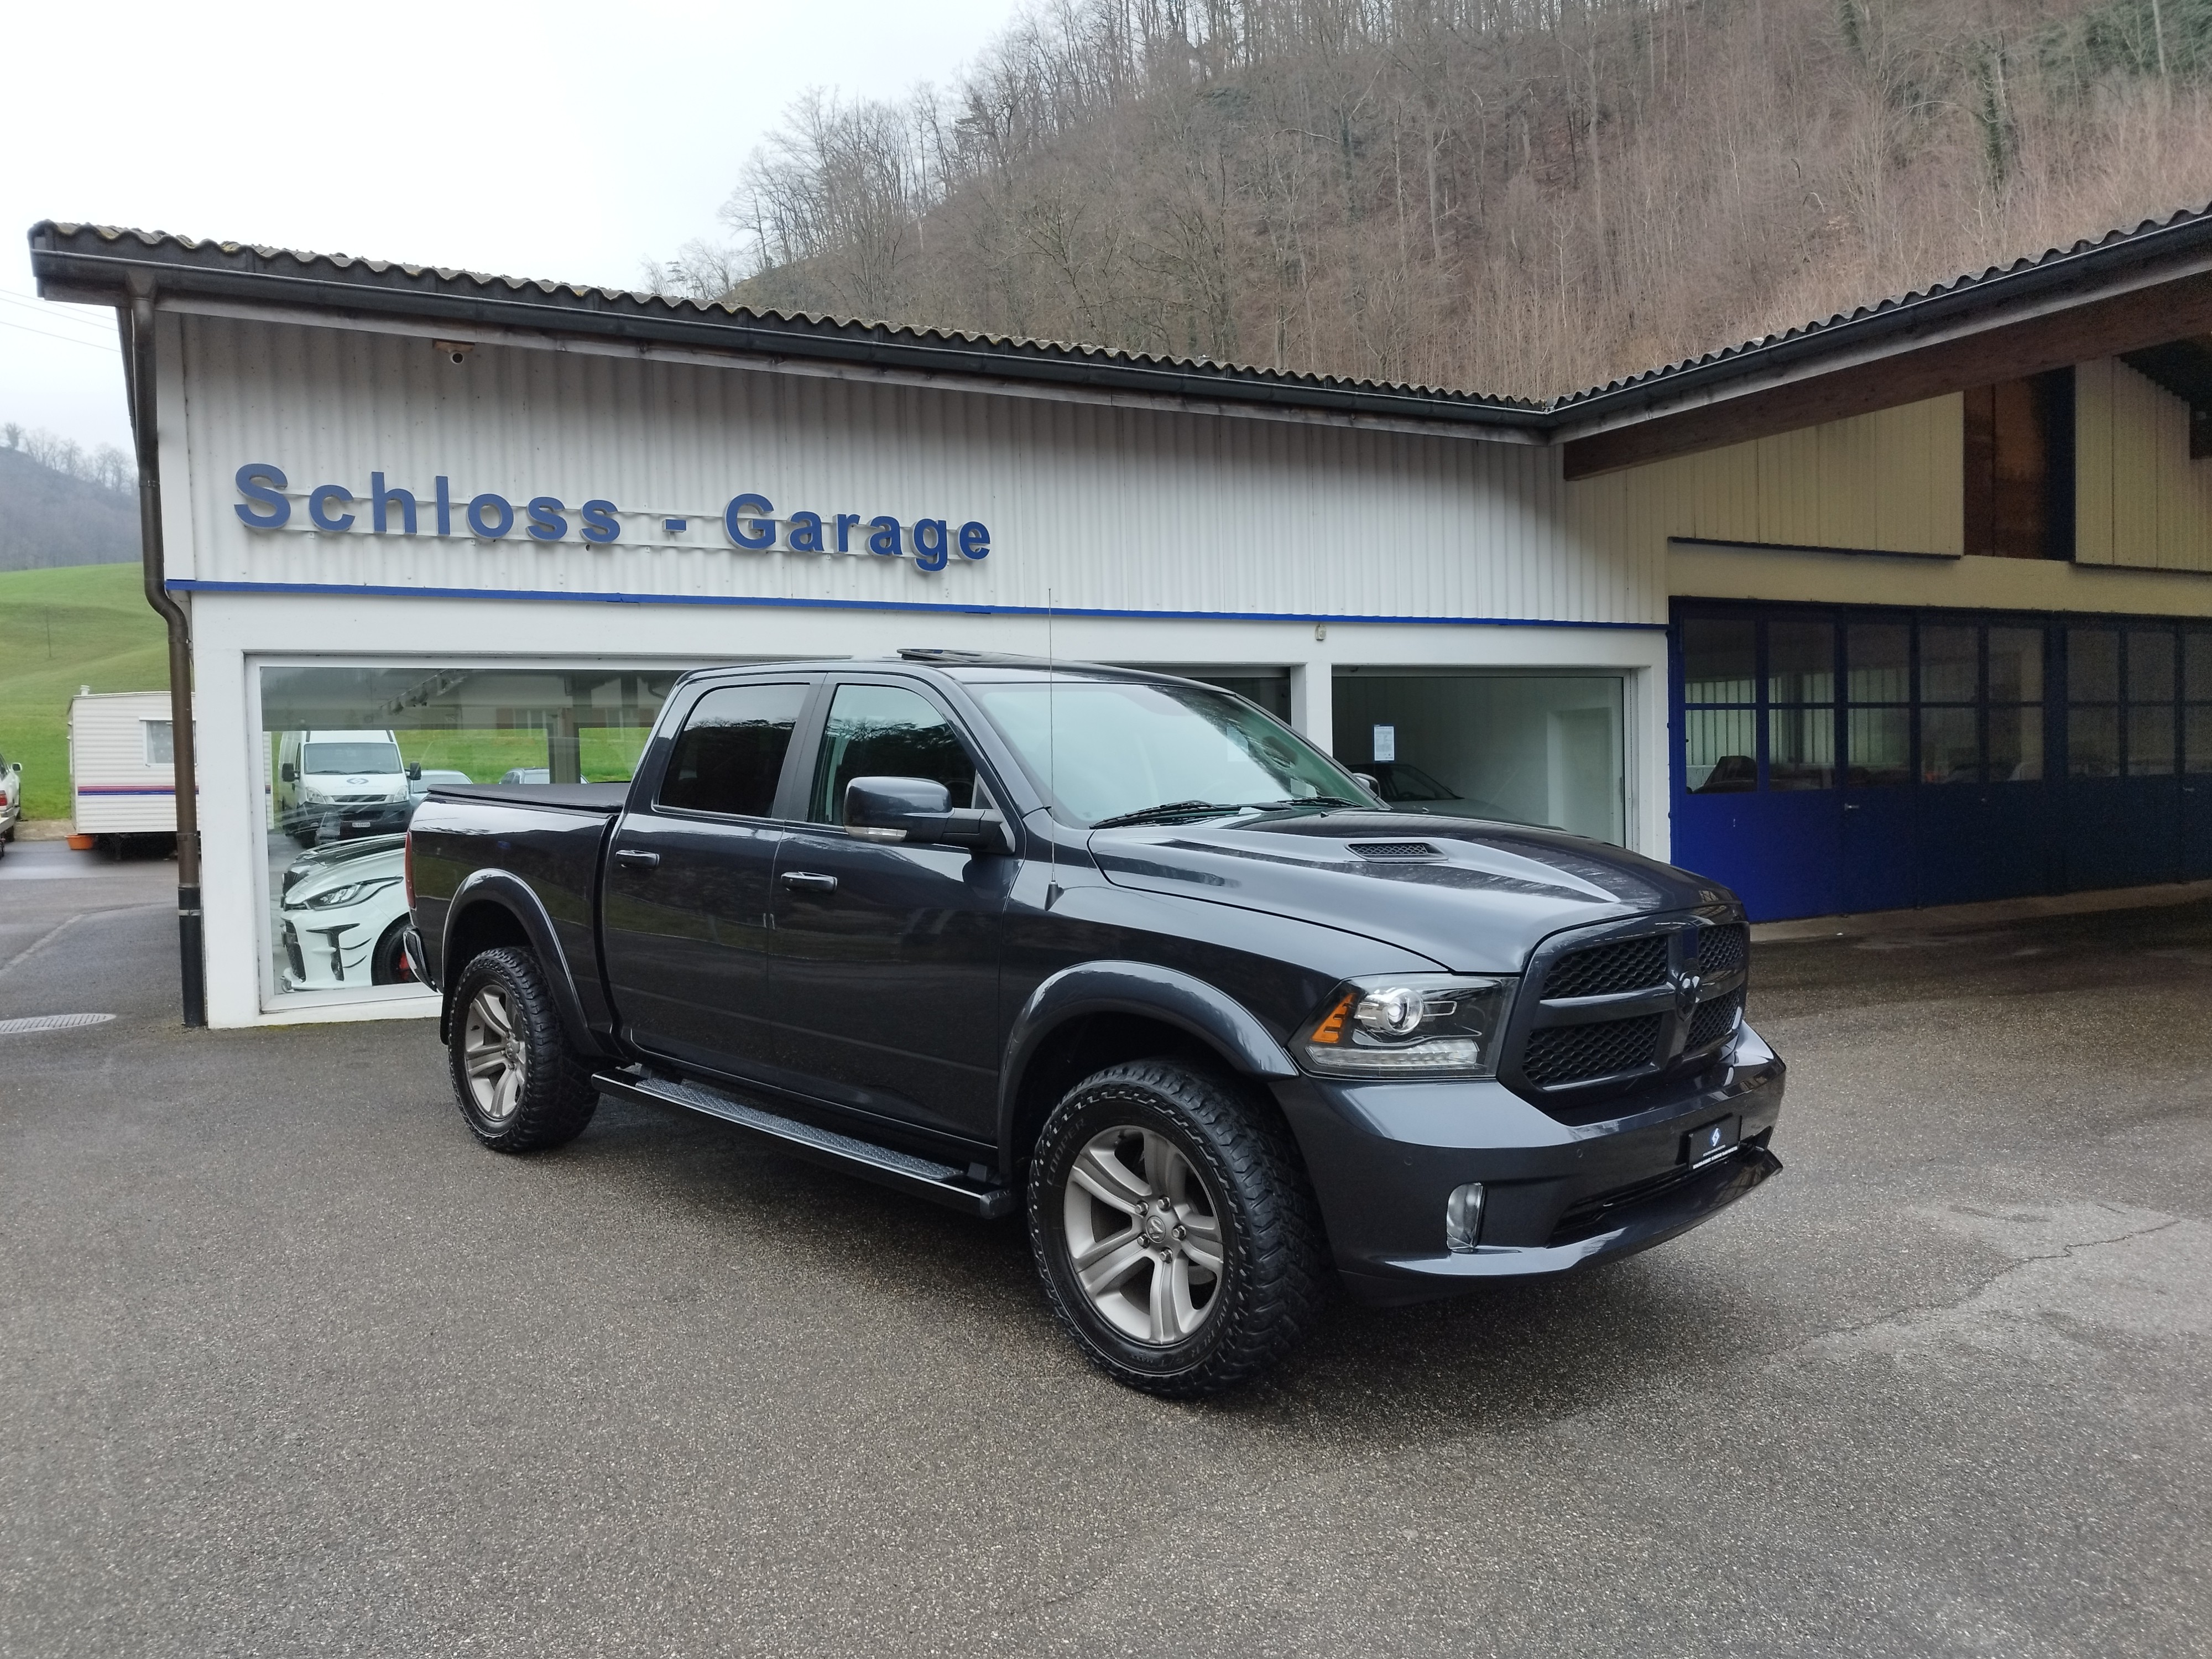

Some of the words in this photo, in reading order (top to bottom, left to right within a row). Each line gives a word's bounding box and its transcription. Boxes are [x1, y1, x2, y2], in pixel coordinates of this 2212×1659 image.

[233, 463, 621, 544] Schloss
[662, 518, 687, 533] -
[723, 492, 991, 572] Garage
[1046, 1118, 1086, 1186] COOPER
